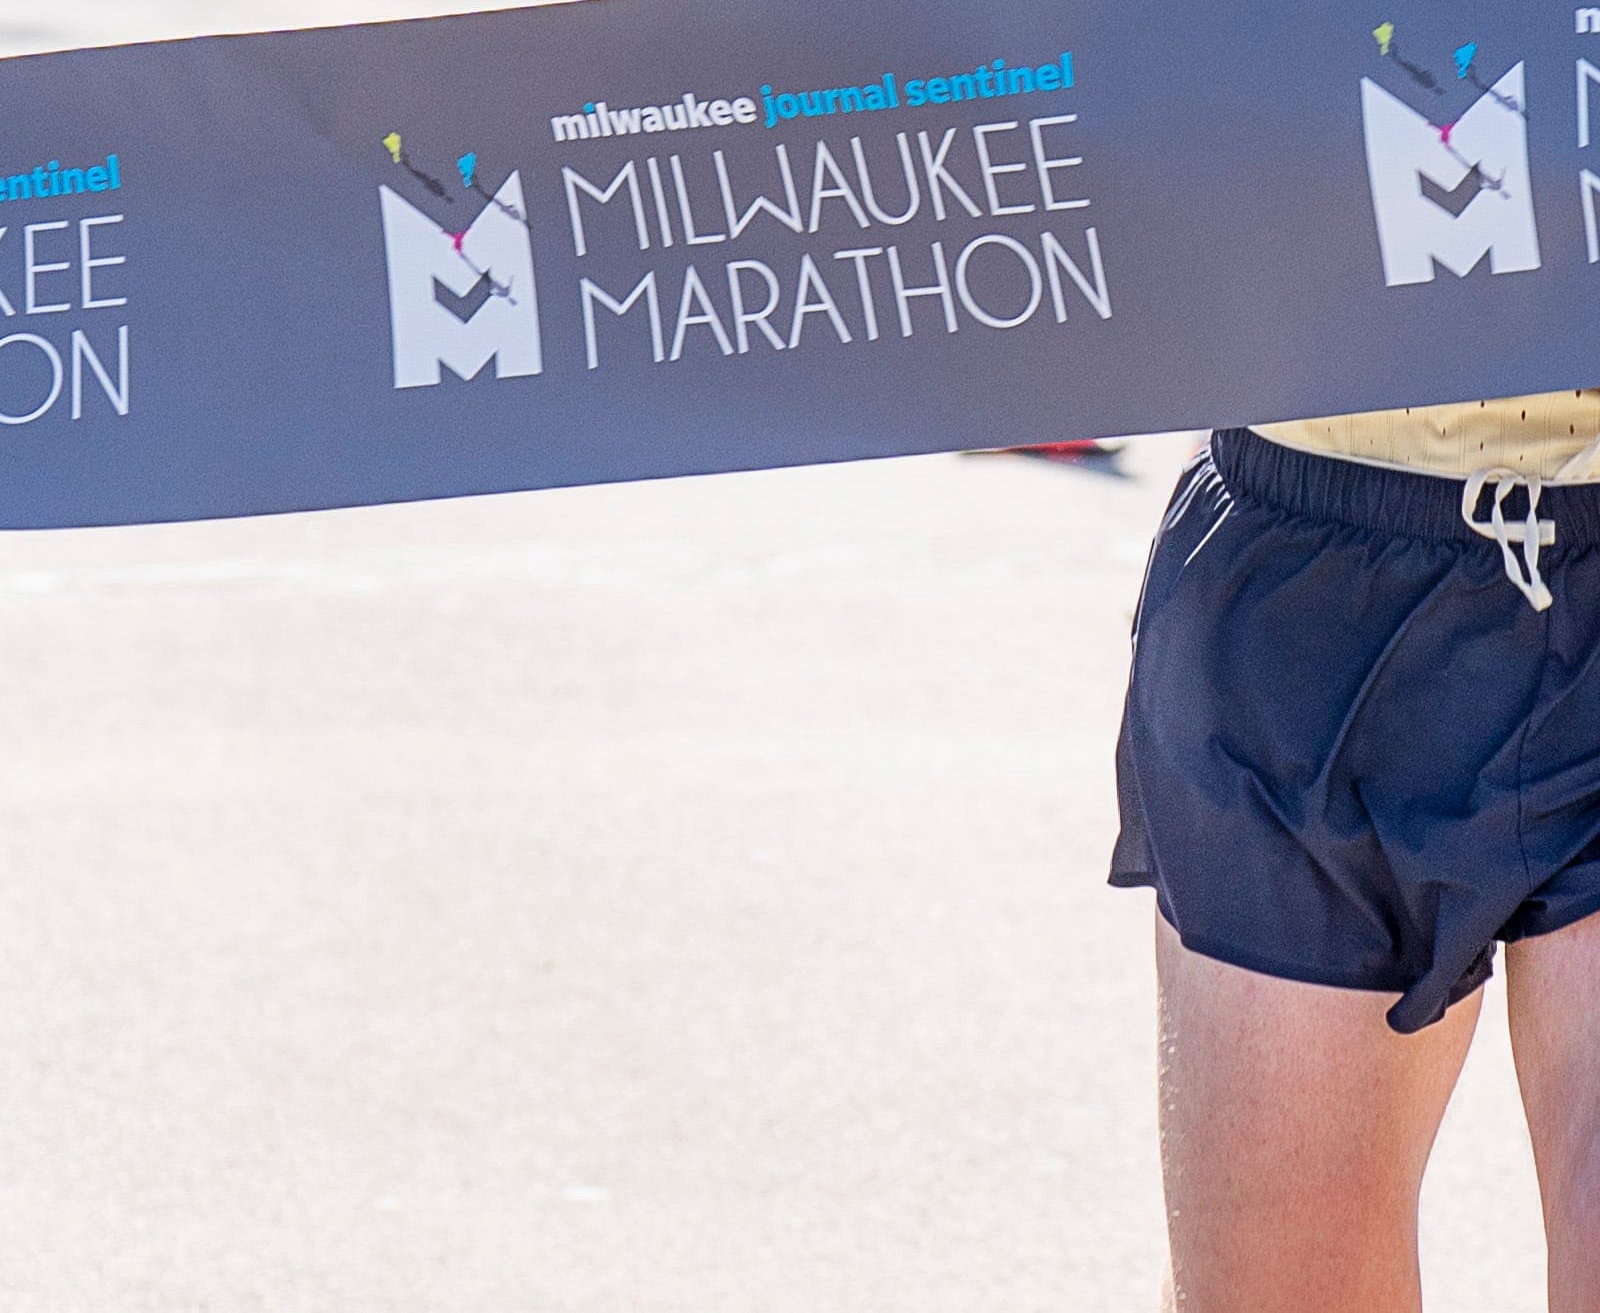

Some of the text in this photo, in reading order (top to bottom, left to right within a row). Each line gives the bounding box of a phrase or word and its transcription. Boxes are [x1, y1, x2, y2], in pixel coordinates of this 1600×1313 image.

[551, 52, 1075, 141] milwaukee journal sentinel
[562, 114, 1091, 257] MILWAUKEE
[579, 227, 1113, 371] MARATHON
